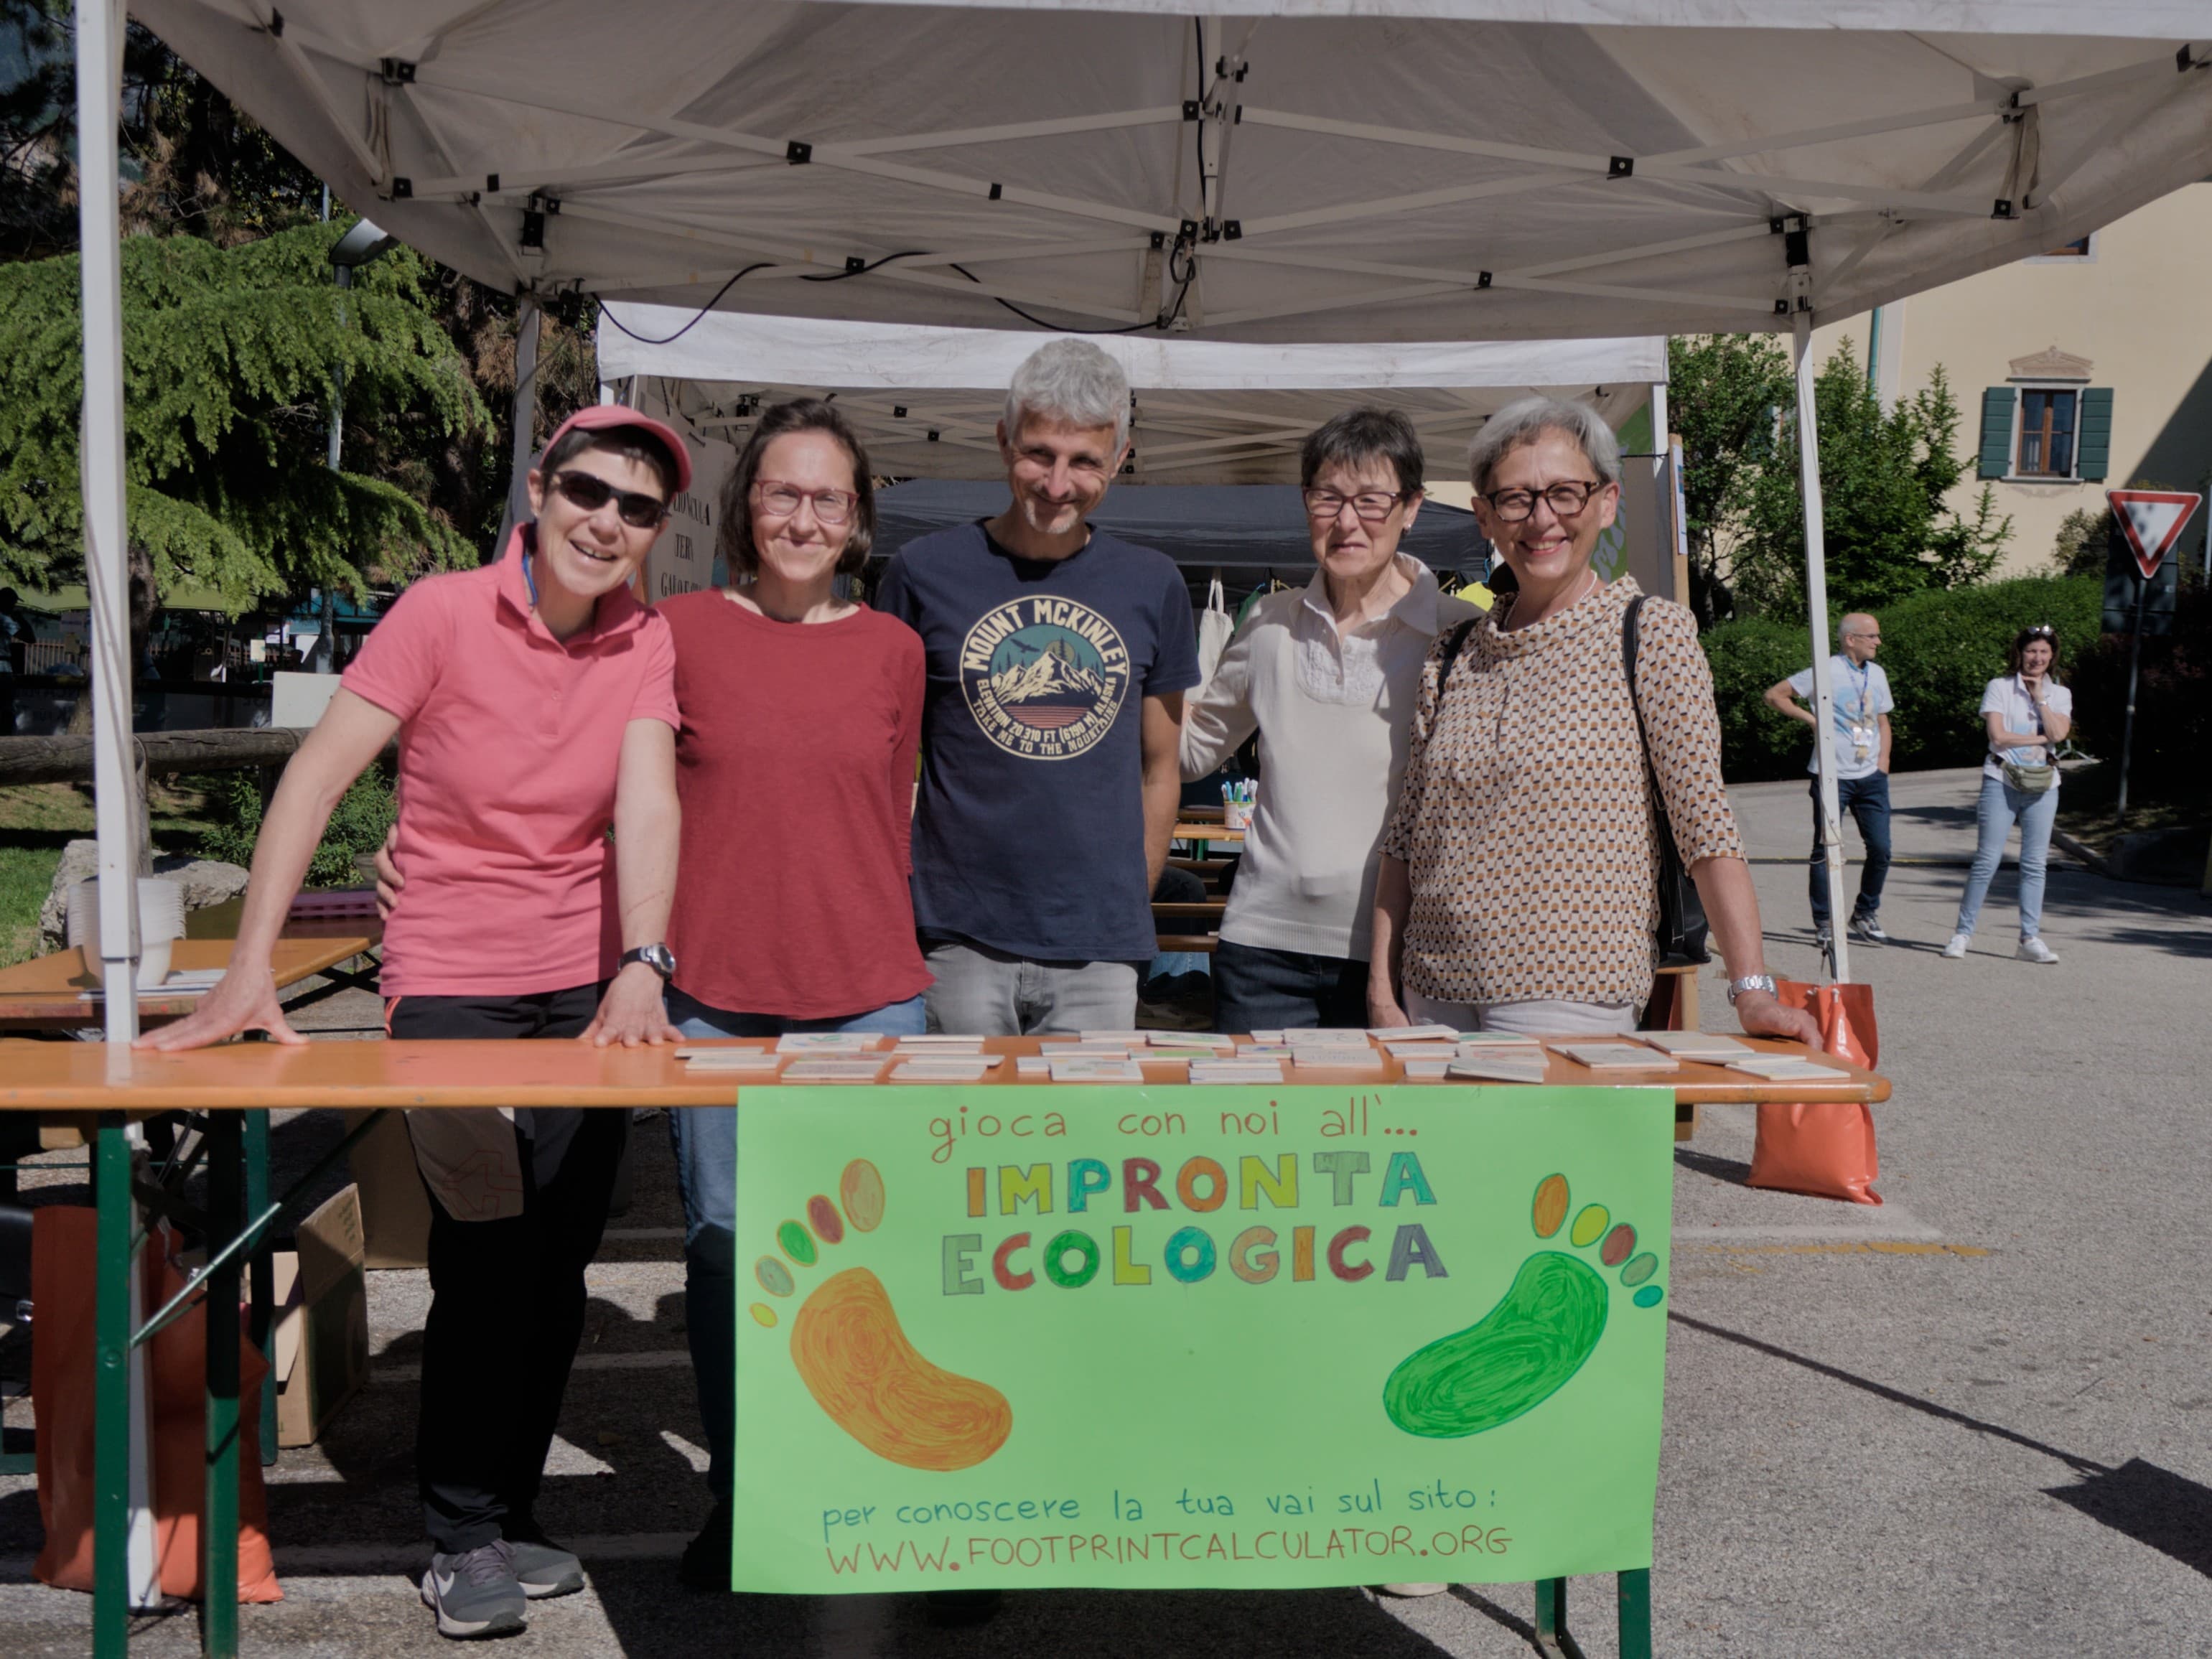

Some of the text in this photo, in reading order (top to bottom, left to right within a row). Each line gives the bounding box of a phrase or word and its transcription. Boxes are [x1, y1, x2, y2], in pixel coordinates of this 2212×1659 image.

[963, 599, 1126, 676] MOUNT MCKINLEY
[976, 678, 1012, 728] ELEVATION
[1044, 730, 1056, 743] FT
[997, 729, 1015, 746] ME
[1019, 739, 1034, 753] TO
[1040, 742, 1063, 755] THE
[929, 1106, 1067, 1163] gioca
[1117, 1112, 1185, 1136] con
[1221, 1100, 1279, 1136] noi
[966, 1150, 1437, 1218] IMPRONTA
[942, 1223, 1450, 1296] ECOLOGICA
[822, 1506, 876, 1543] per
[896, 1500, 1081, 1524] conoscere
[1114, 1490, 1143, 1521] la
[1175, 1487, 1234, 1516] tua
[1266, 1485, 1314, 1515] vai
[1338, 1478, 1381, 1513] sul
[826, 1524, 1513, 1575] WWW.FOOTPRINTCALCULATOR.ORG
